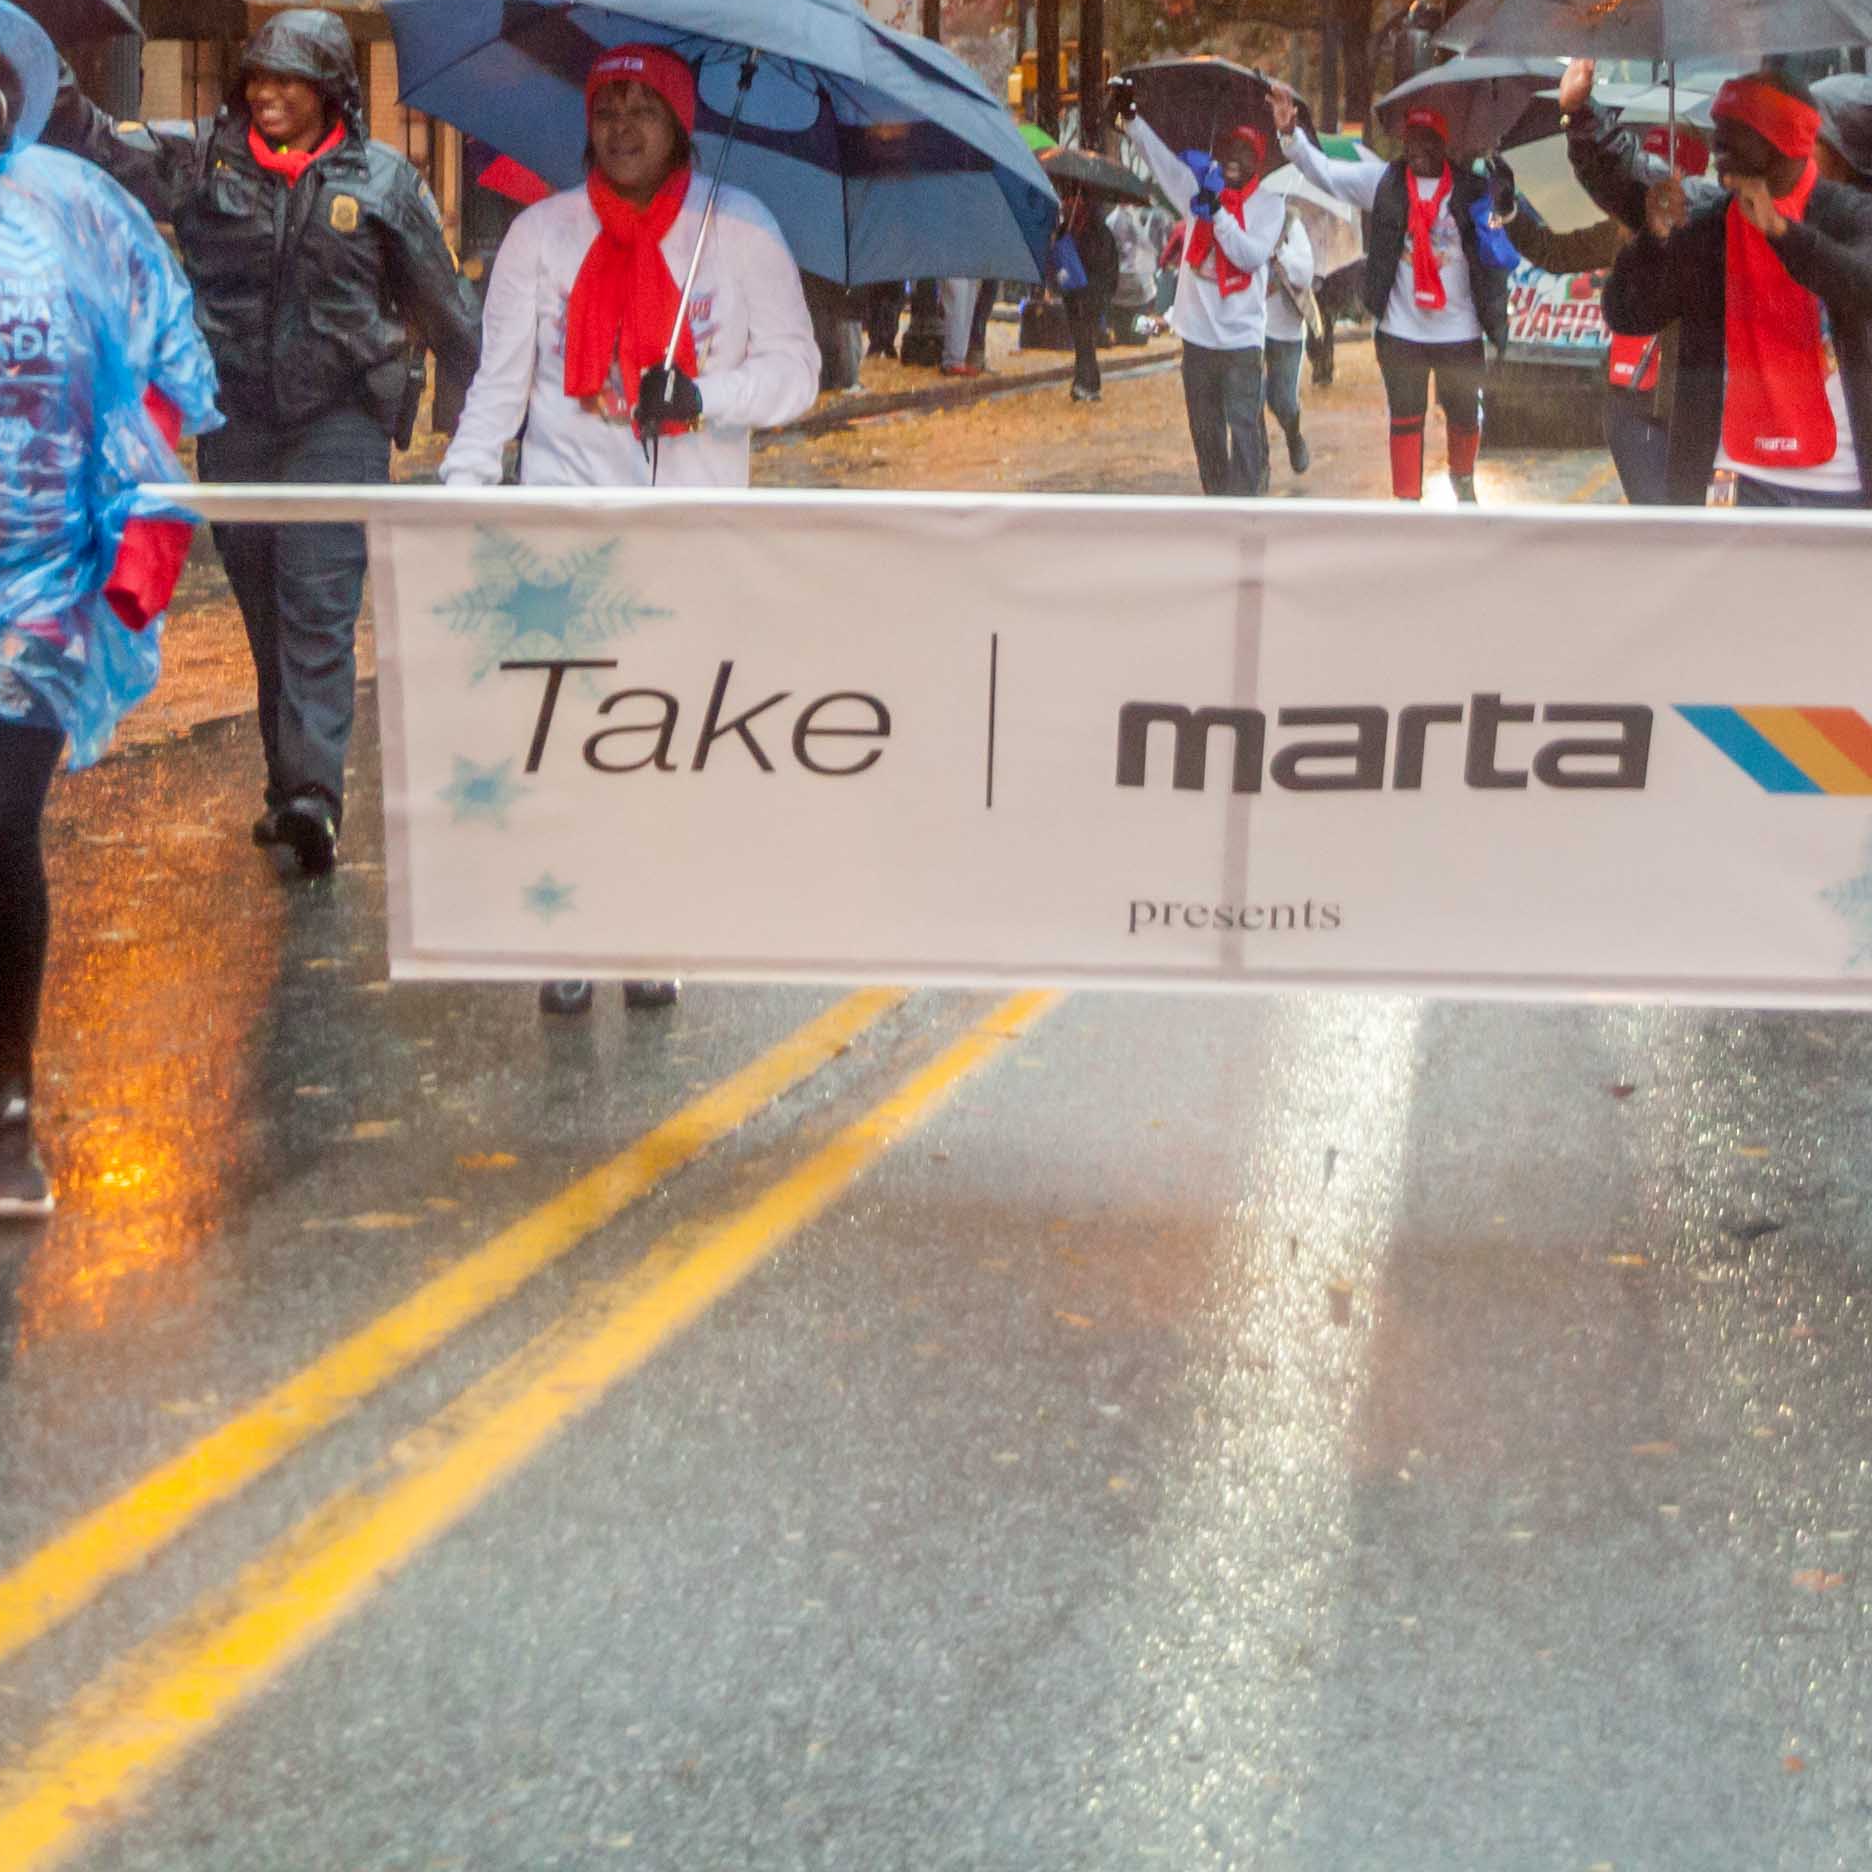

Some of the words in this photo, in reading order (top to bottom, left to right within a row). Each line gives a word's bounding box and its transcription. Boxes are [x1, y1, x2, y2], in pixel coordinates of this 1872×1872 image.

[498, 659, 892, 778] Take
[1115, 692, 1655, 795] marta
[1127, 893, 1343, 934] presents
